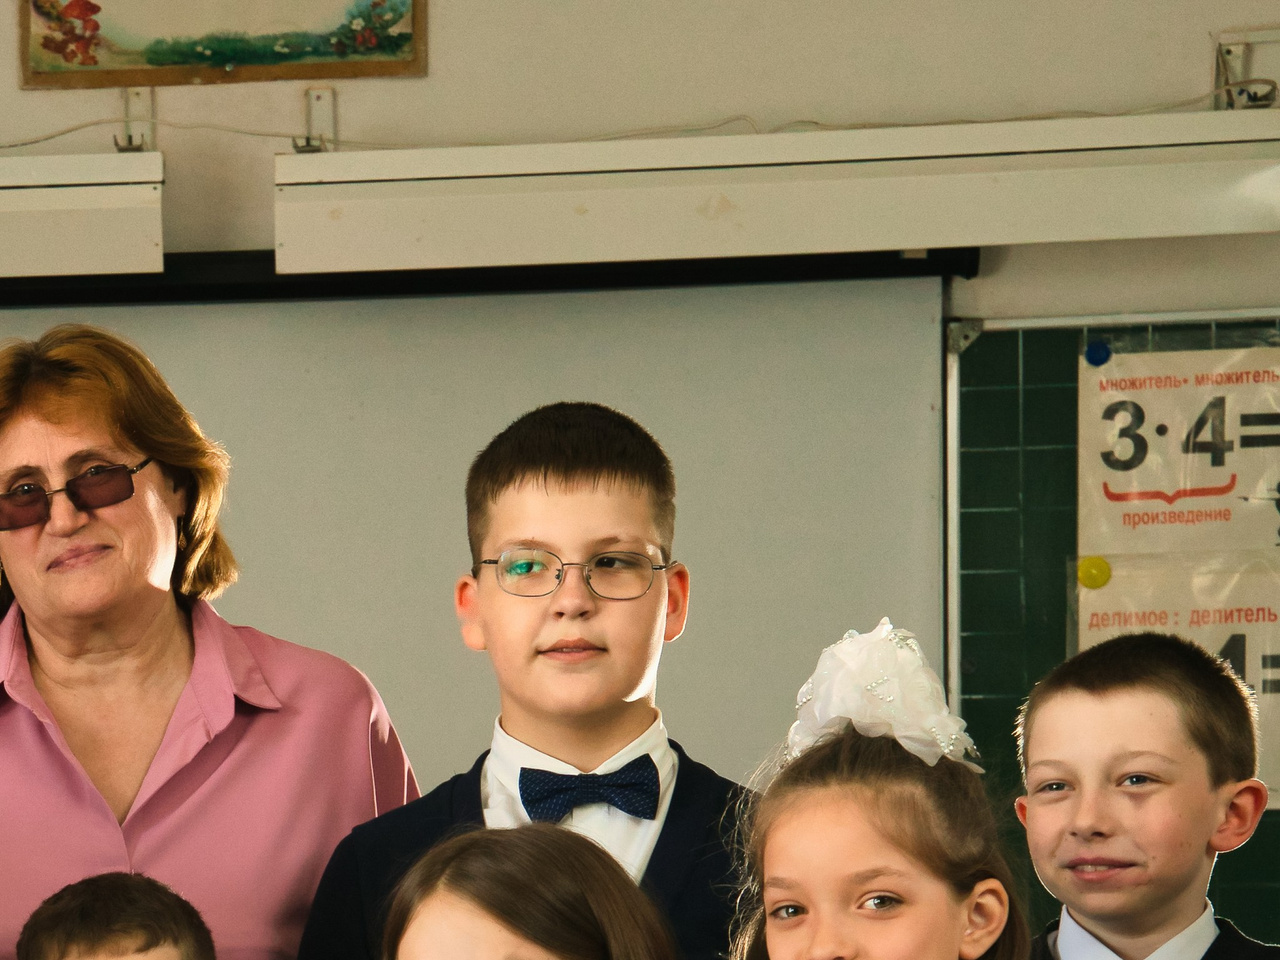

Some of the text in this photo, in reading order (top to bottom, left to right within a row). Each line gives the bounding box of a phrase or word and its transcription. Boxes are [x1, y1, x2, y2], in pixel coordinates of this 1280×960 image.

[1122, 508, 1233, 529] произведение
[1088, 610, 1169, 630] делимое
[1188, 606, 1279, 627] делитель
